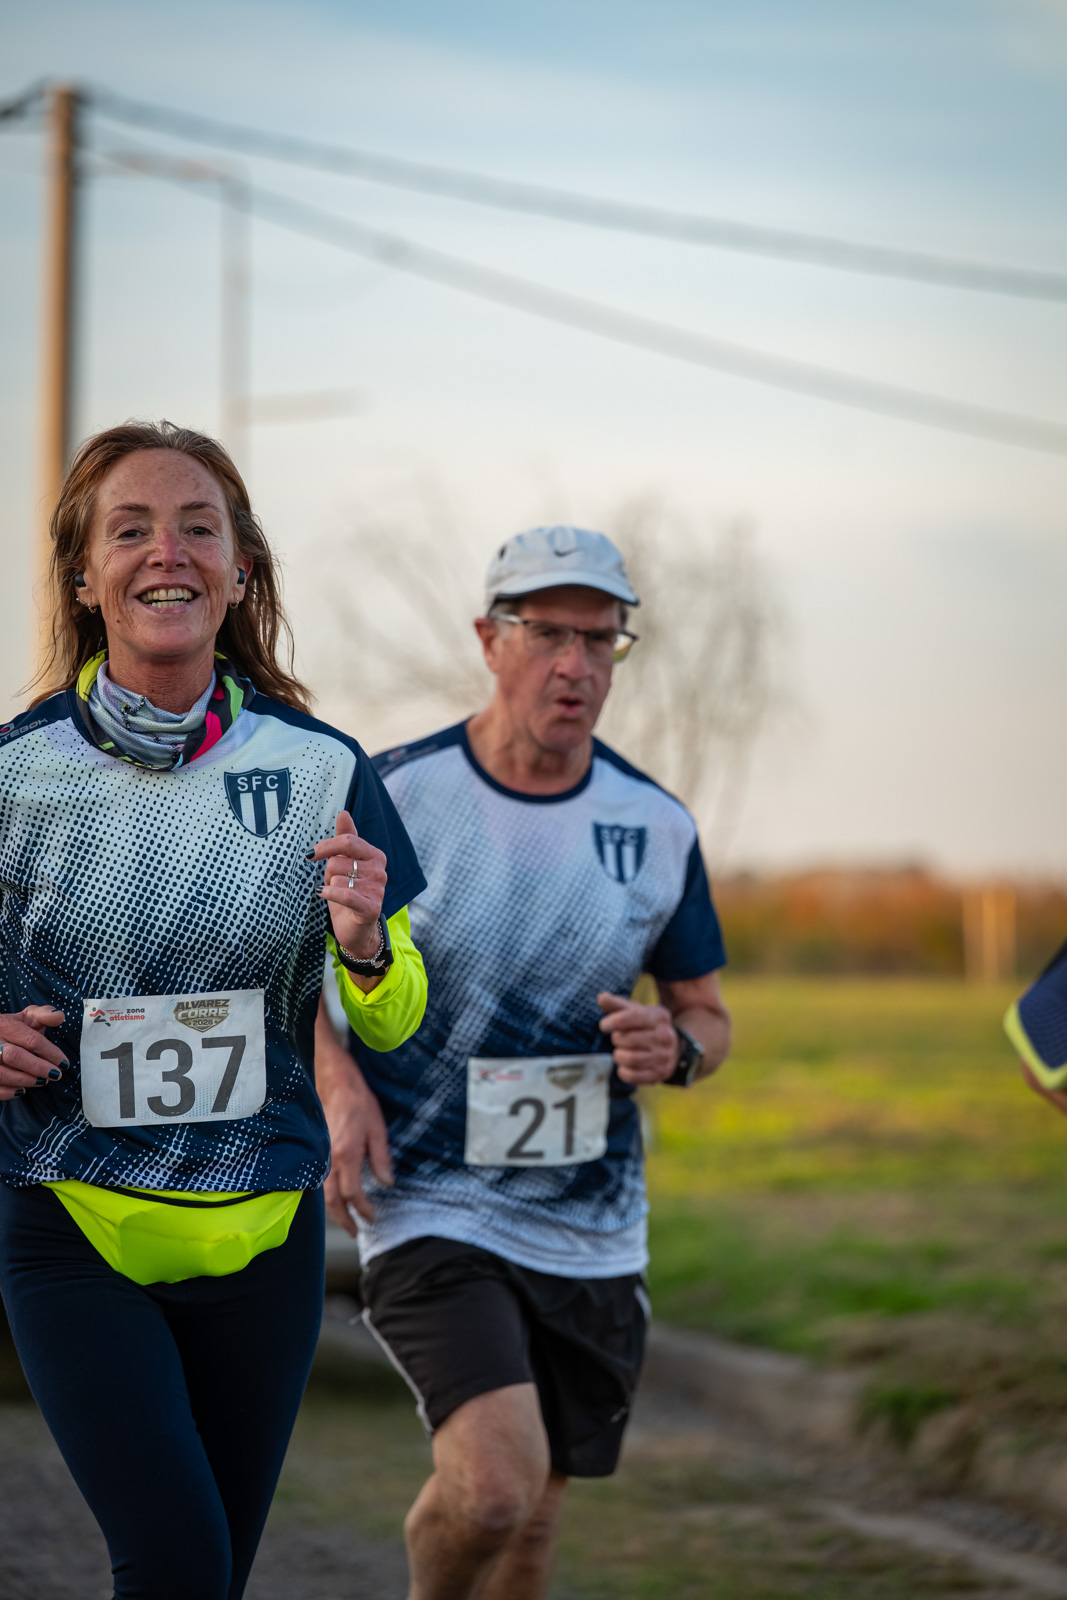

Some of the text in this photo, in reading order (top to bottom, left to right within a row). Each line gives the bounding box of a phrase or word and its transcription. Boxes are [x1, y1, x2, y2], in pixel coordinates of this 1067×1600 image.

[237, 775, 279, 792] SFC
[175, 999, 231, 1012] ALVAREZ
[109, 1013, 145, 1021] atletismo
[177, 1008, 229, 1020] CORRE
[100, 1035, 246, 1119] 137
[506, 1095, 576, 1159] 21
